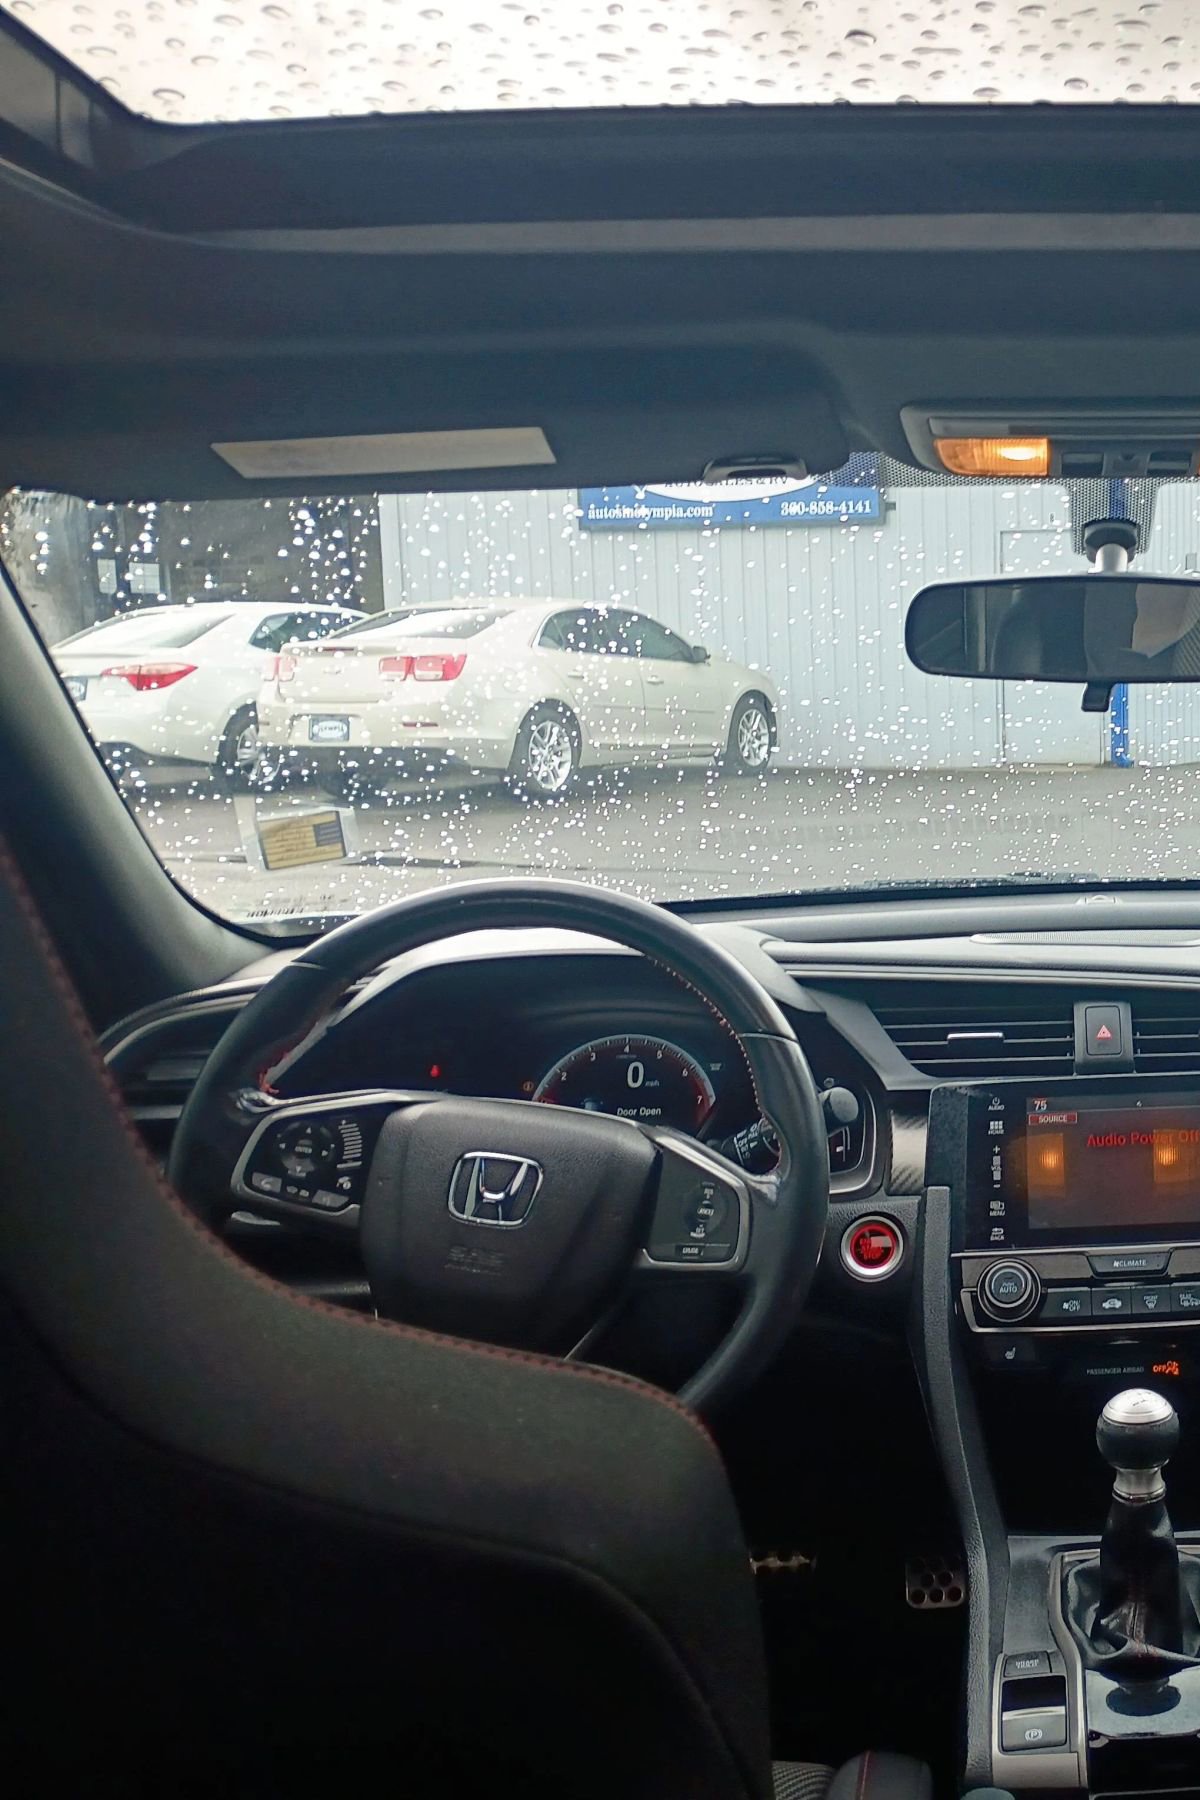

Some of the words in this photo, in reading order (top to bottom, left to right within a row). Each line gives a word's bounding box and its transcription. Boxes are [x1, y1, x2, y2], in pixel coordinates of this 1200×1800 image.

[627, 1061, 644, 1088] 0
[1034, 1100, 1047, 1111] 75
[617, 1107, 637, 1116] Door
[640, 1106, 661, 1116] Open
[1038, 1114, 1067, 1123] SOURCE
[1087, 1133, 1126, 1147] Audio
[1130, 1131, 1173, 1145] Power
[1178, 1129, 1200, 1142] Off
[1119, 1259, 1147, 1267] CLIMATE
[1000, 1286, 1017, 1294] AUTO
